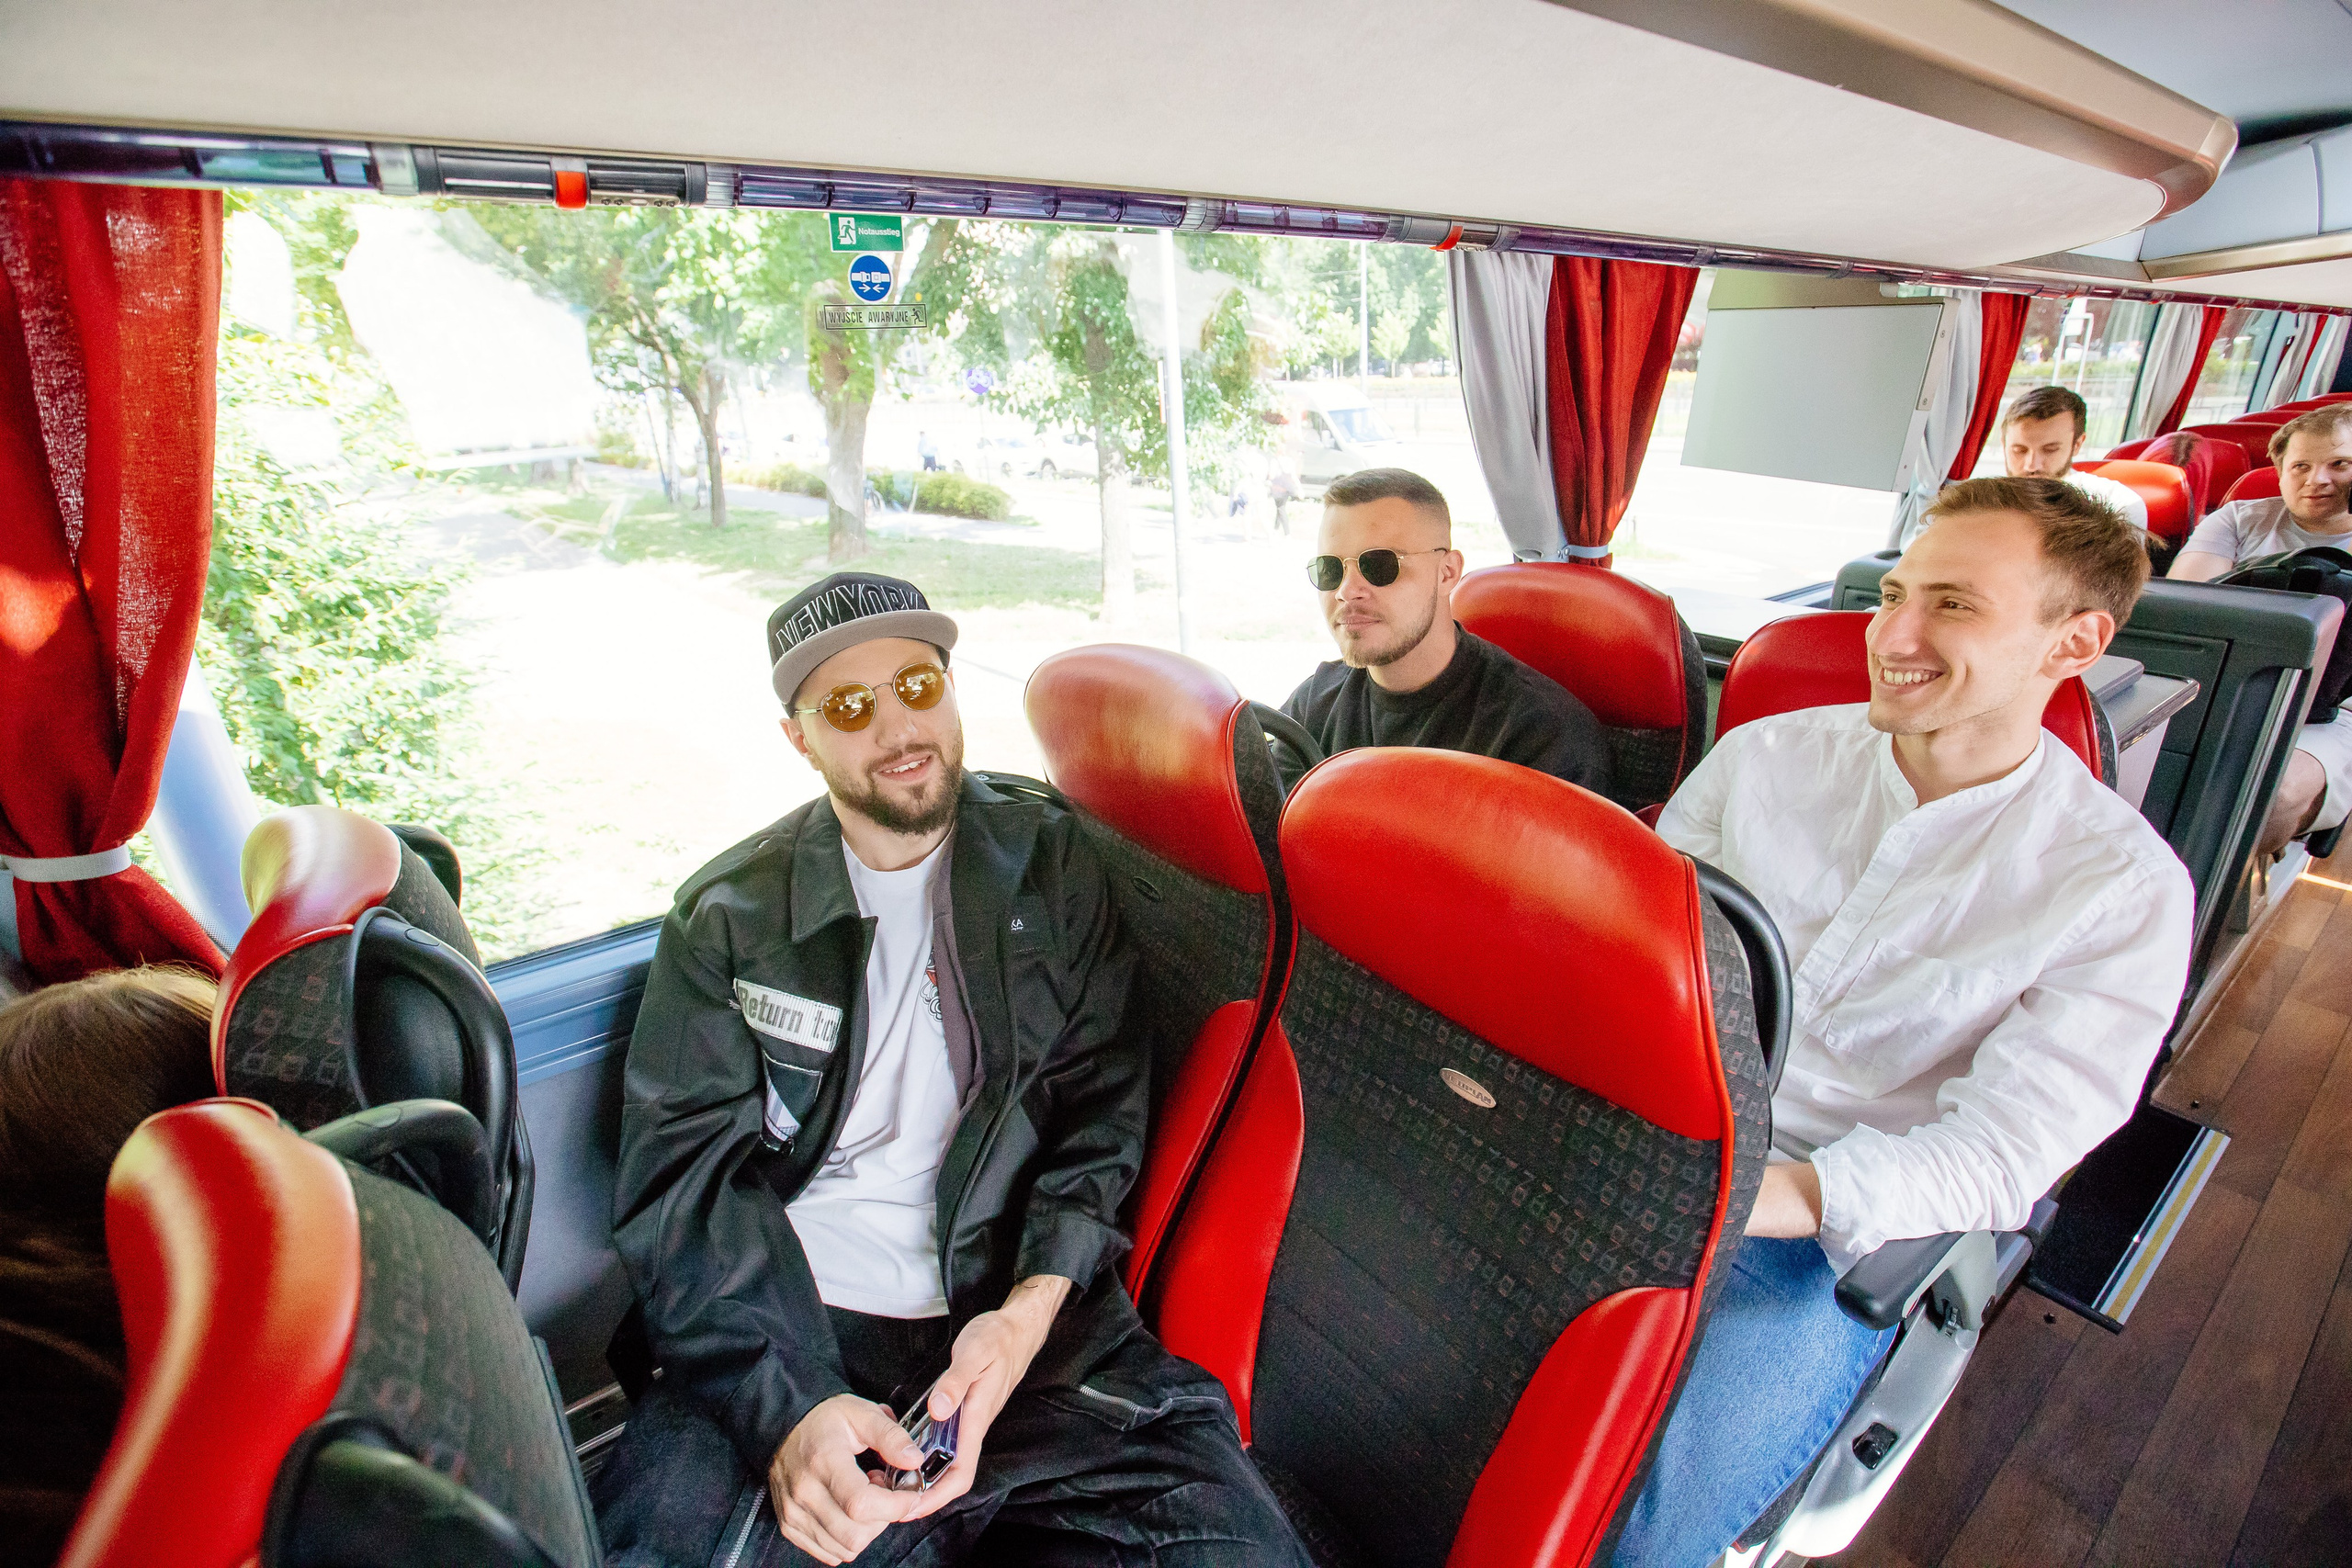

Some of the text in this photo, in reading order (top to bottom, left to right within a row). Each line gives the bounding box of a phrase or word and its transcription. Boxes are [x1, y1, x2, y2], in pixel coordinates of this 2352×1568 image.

[858, 227, 900, 237] Notausstieg
[868, 310, 909, 323] AWARYJNE
[738, 986, 804, 1034] Return
